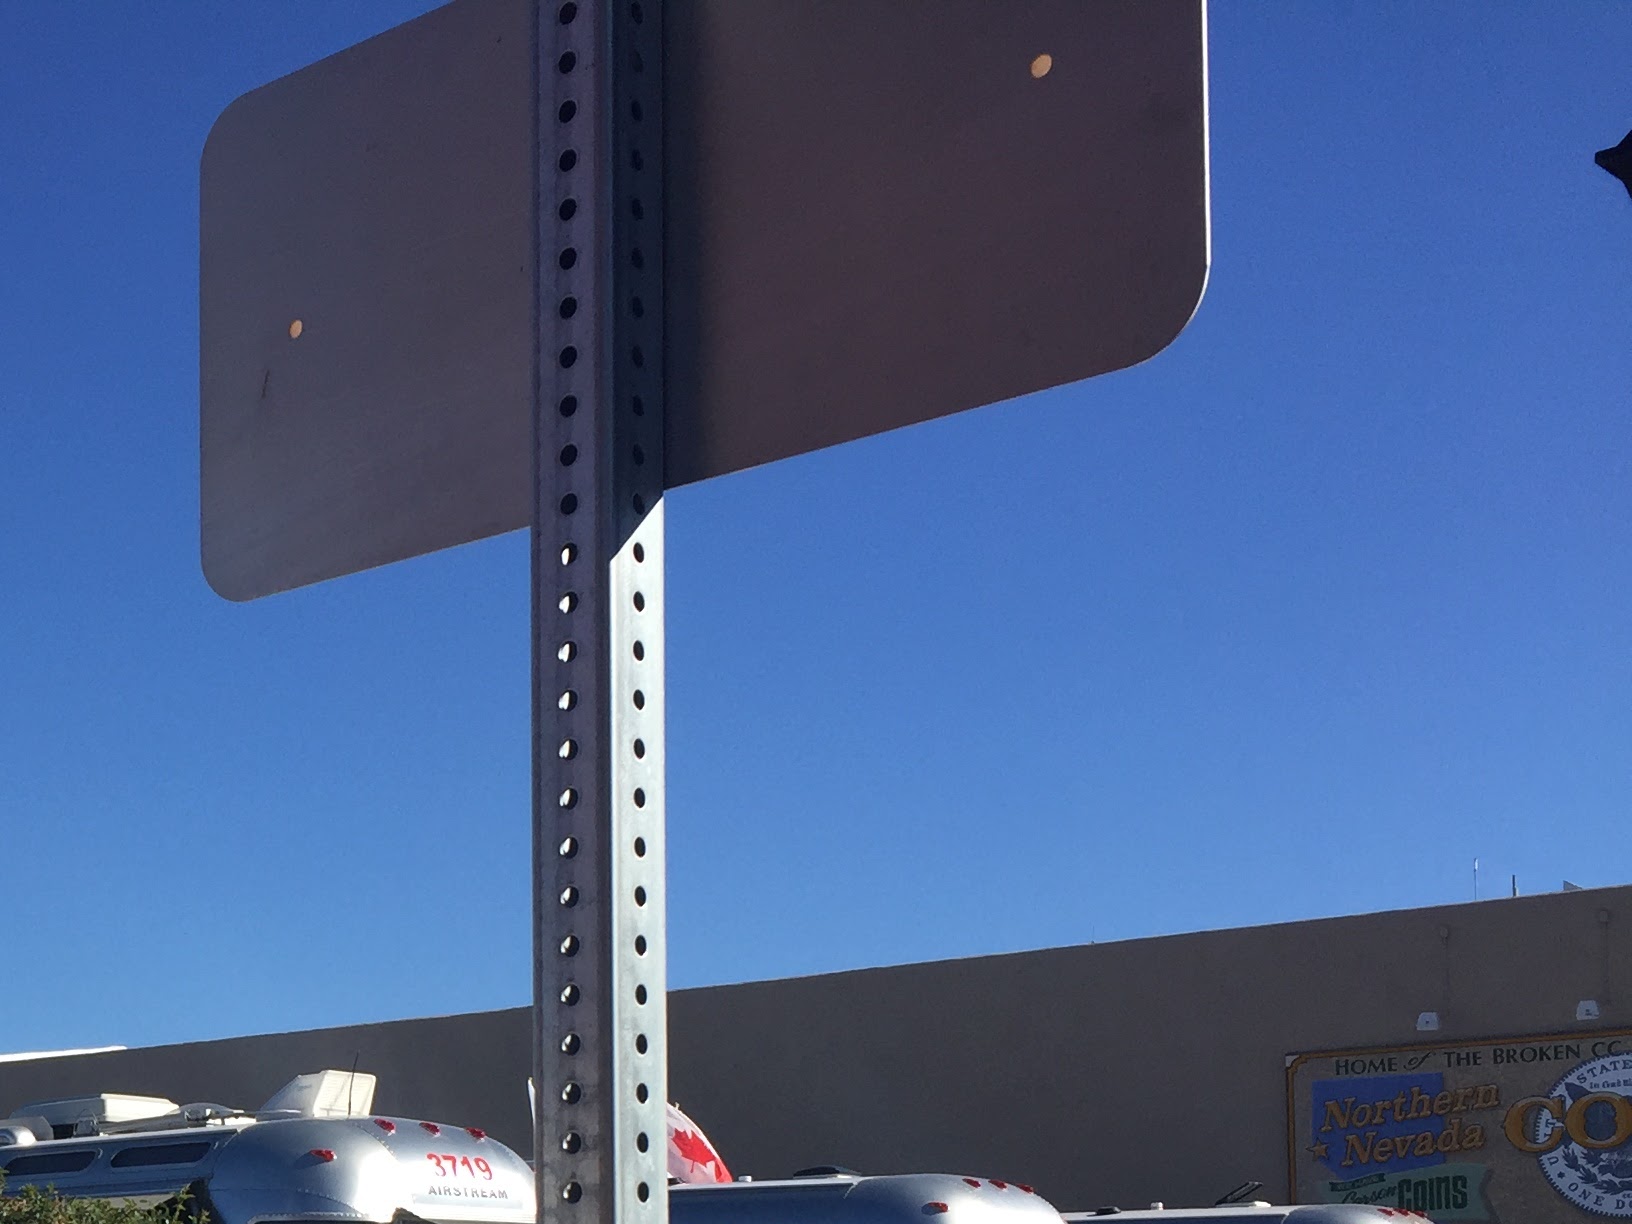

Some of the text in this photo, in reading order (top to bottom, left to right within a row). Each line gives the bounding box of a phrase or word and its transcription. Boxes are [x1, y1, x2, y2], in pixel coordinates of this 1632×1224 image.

[1335, 1057, 1398, 1076] HOME
[1403, 1051, 1436, 1071] of
[1444, 1051, 1482, 1067] THE
[1493, 1044, 1580, 1065] BROKEN
[1320, 1083, 1501, 1133] Northern
[1341, 1117, 1486, 1167] Nevada
[427, 1153, 493, 1181] 3719
[428, 1185, 509, 1200] AIRSTREAM
[1568, 1182, 1606, 1207] ONE
